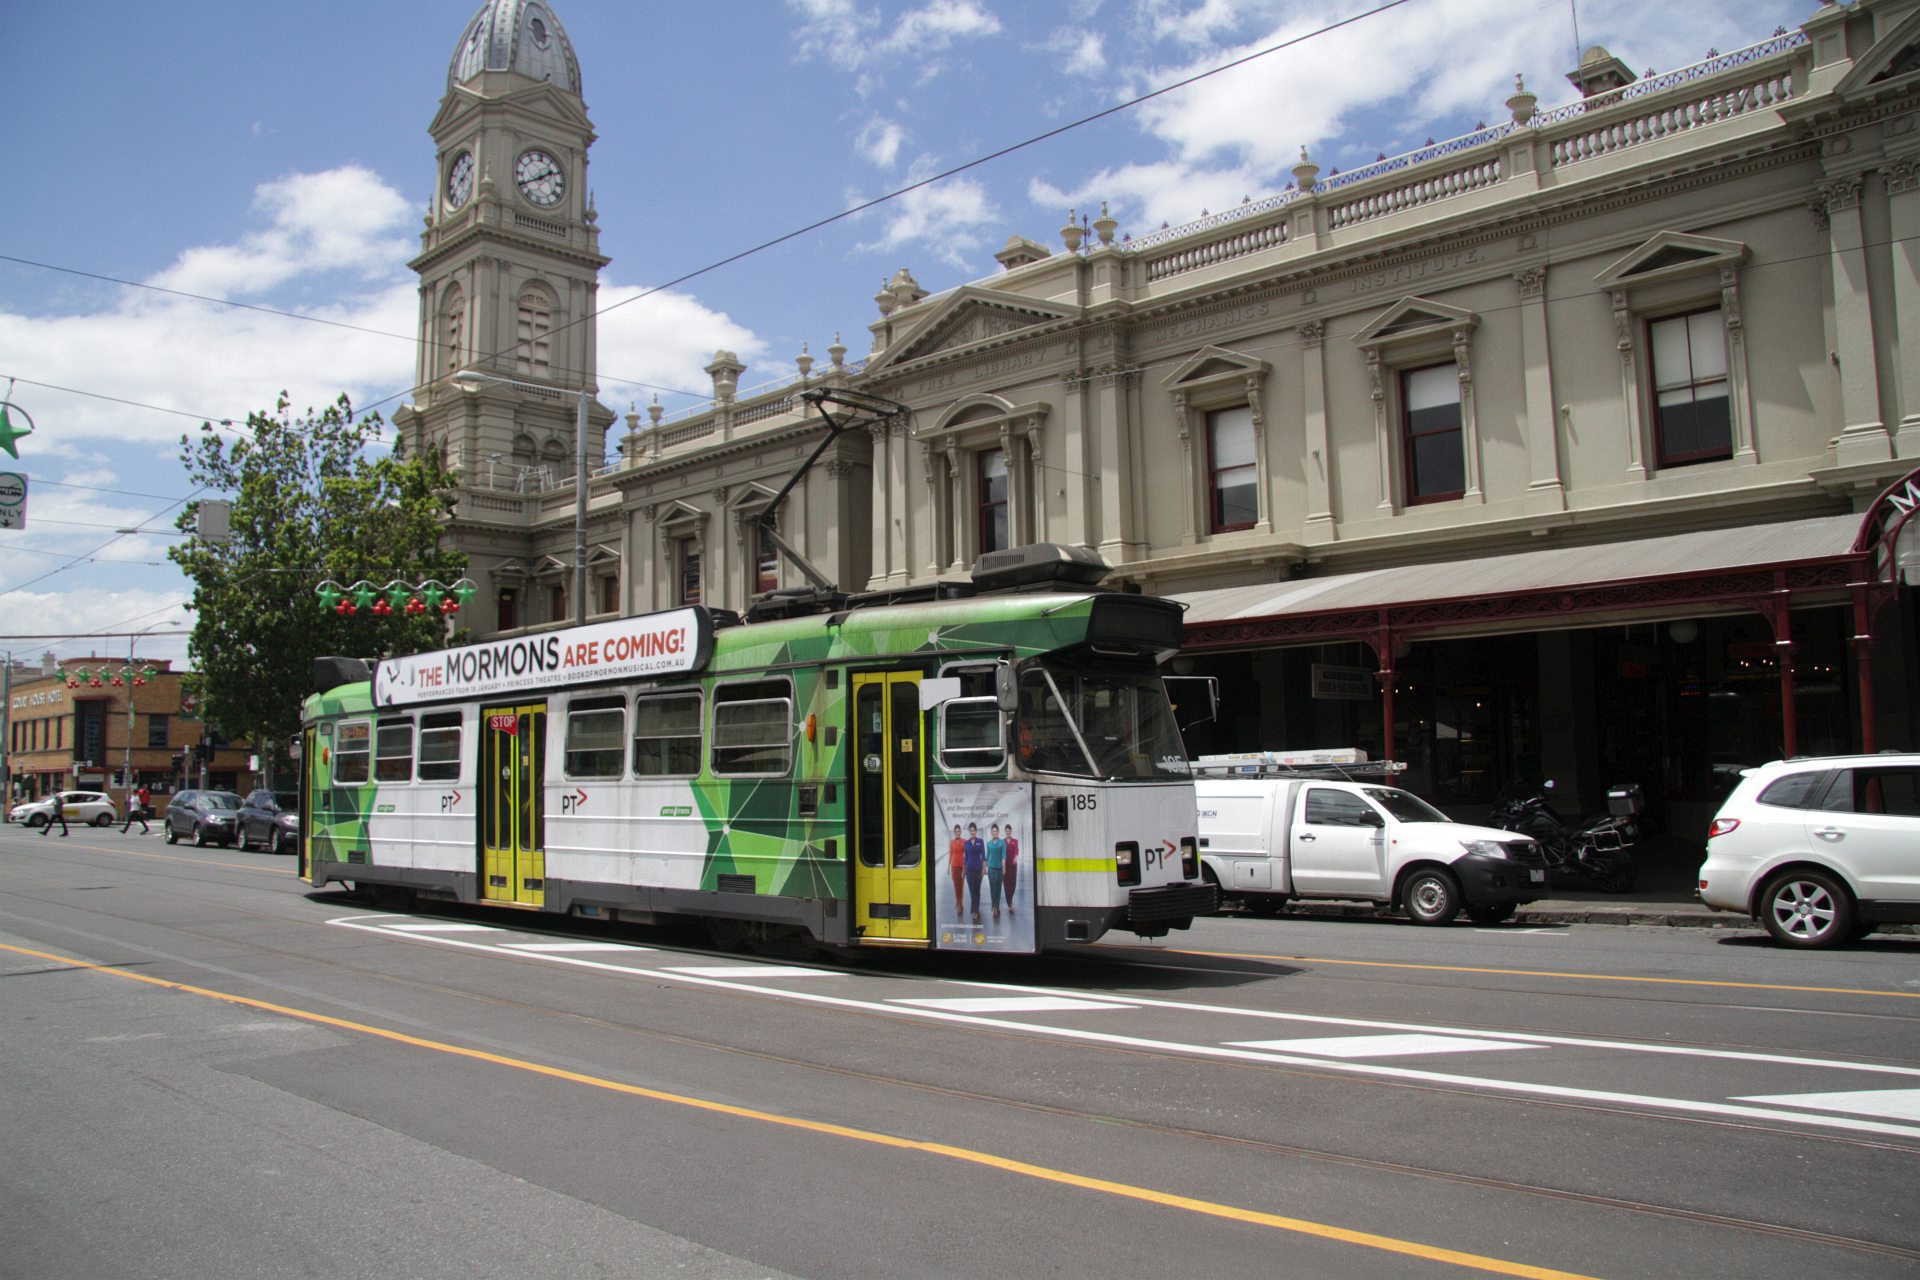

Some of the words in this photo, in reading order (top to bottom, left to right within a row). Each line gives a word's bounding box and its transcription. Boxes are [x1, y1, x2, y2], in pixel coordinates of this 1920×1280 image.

[1152, 303, 1270, 342] MECHANICS
[918, 373, 956, 393] FREE
[974, 349, 1047, 379] LIBRARY
[418, 666, 442, 688] THE
[446, 636, 559, 685] MORMONS
[563, 641, 599, 668] ARE
[603, 627, 685, 662] COMING!
[478, 682, 501, 692] JANUARY
[507, 678, 533, 688] PRINCESS
[535, 674, 561, 684] THEATRE
[567, 658, 685, 680] BOOKOFMORMONMUSICAL.COM.AU
[493, 715, 515, 728] STOP
[1071, 794, 1097, 811] 185
